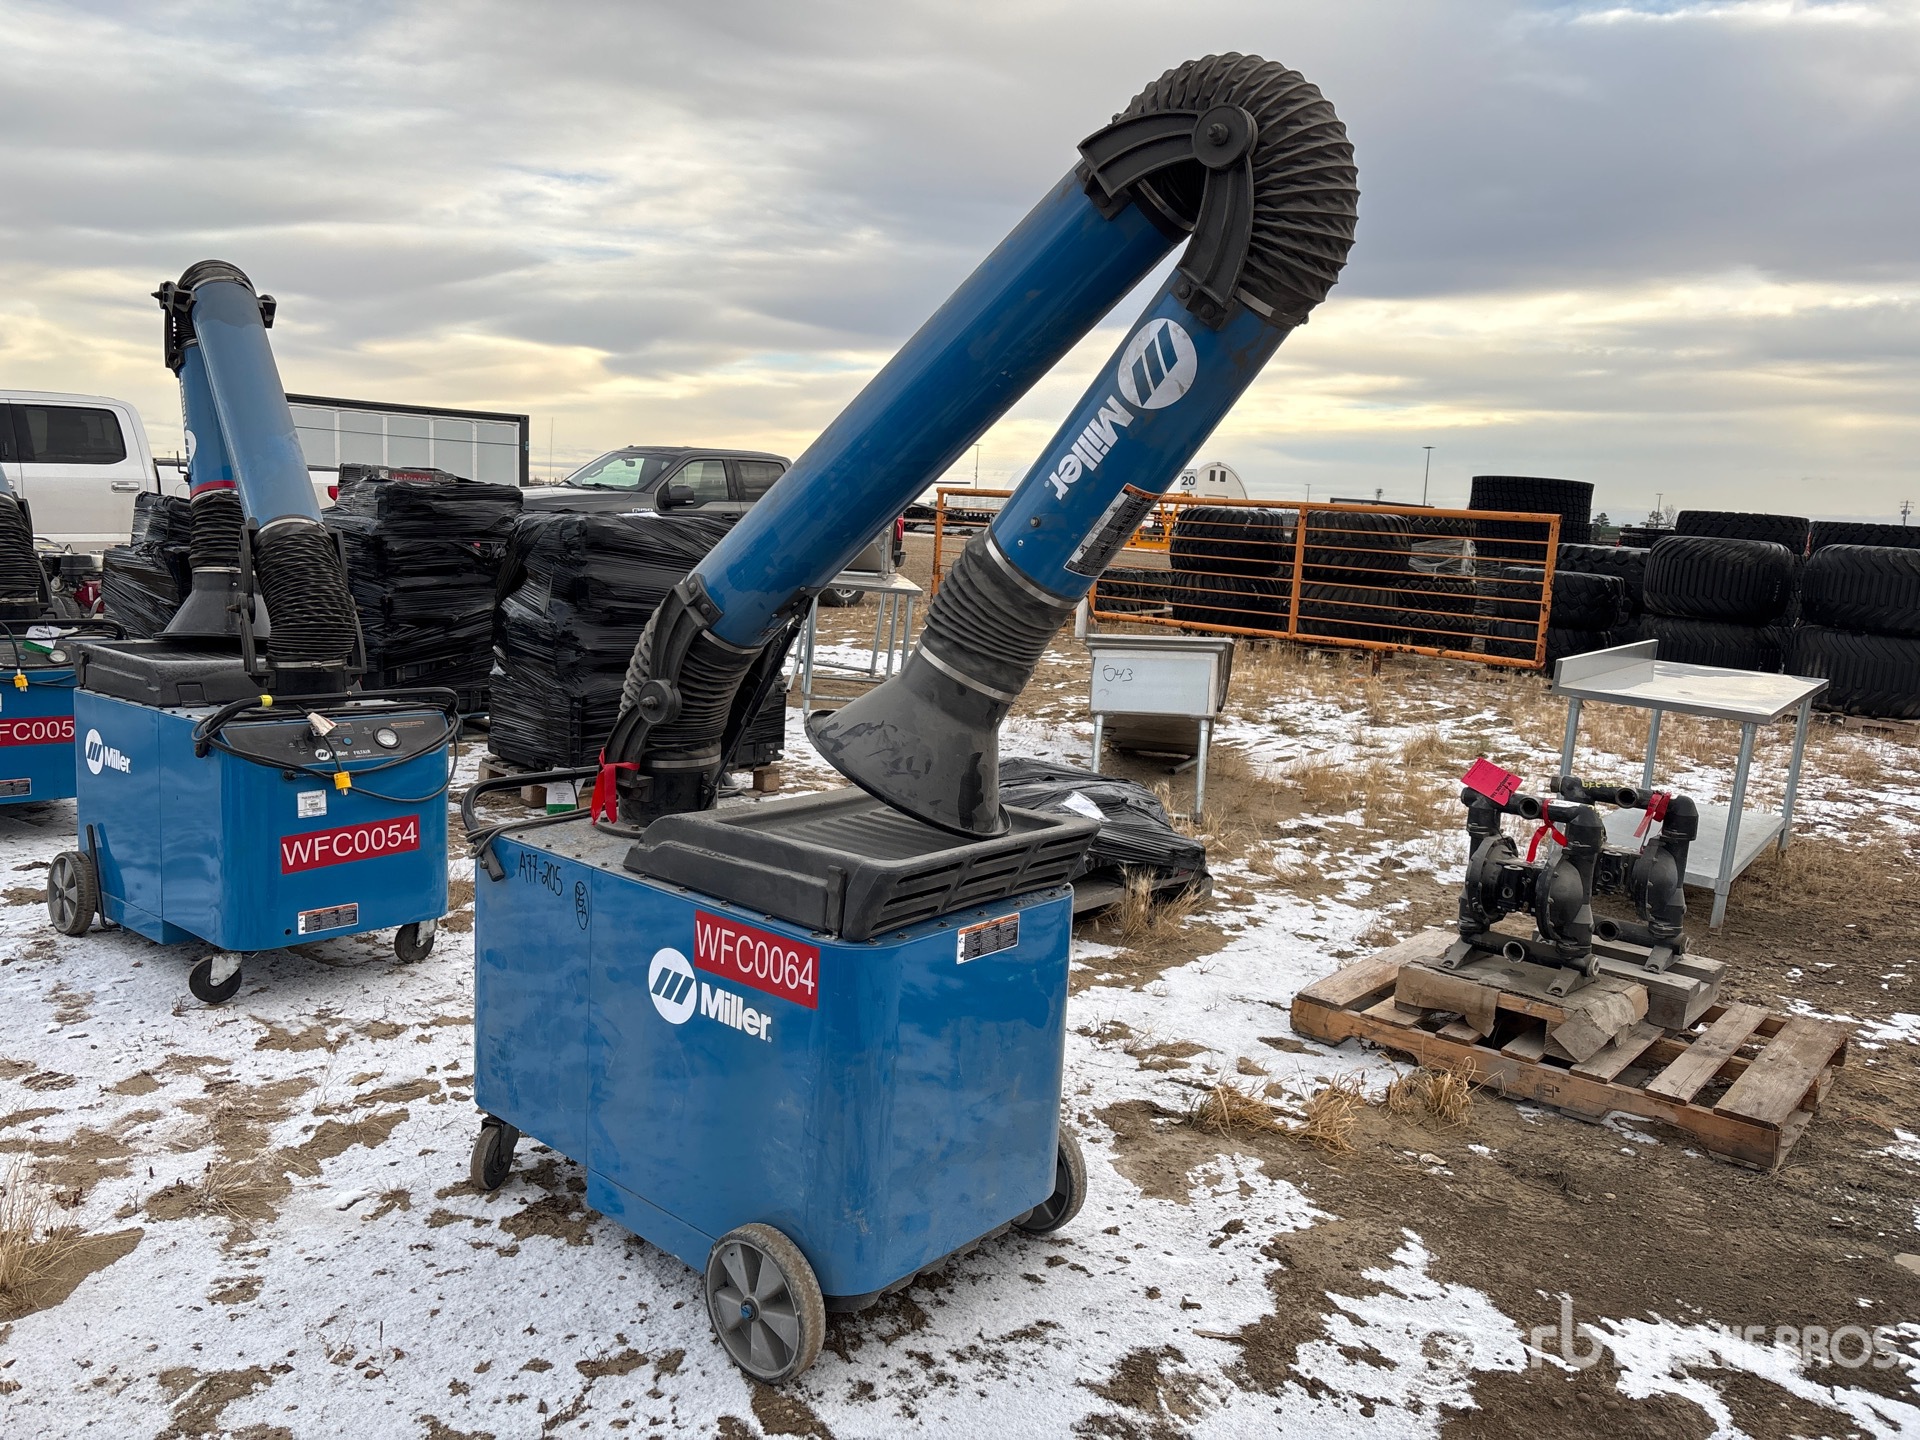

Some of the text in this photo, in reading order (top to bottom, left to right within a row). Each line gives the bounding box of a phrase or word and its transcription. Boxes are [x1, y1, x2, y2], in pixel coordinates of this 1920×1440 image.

[1181, 476, 1196, 486] 20
[104, 746, 130, 773] Miller
[282, 821, 417, 866] WFC0054
[518, 850, 564, 897] A77-205
[696, 920, 815, 995] WFC0064
